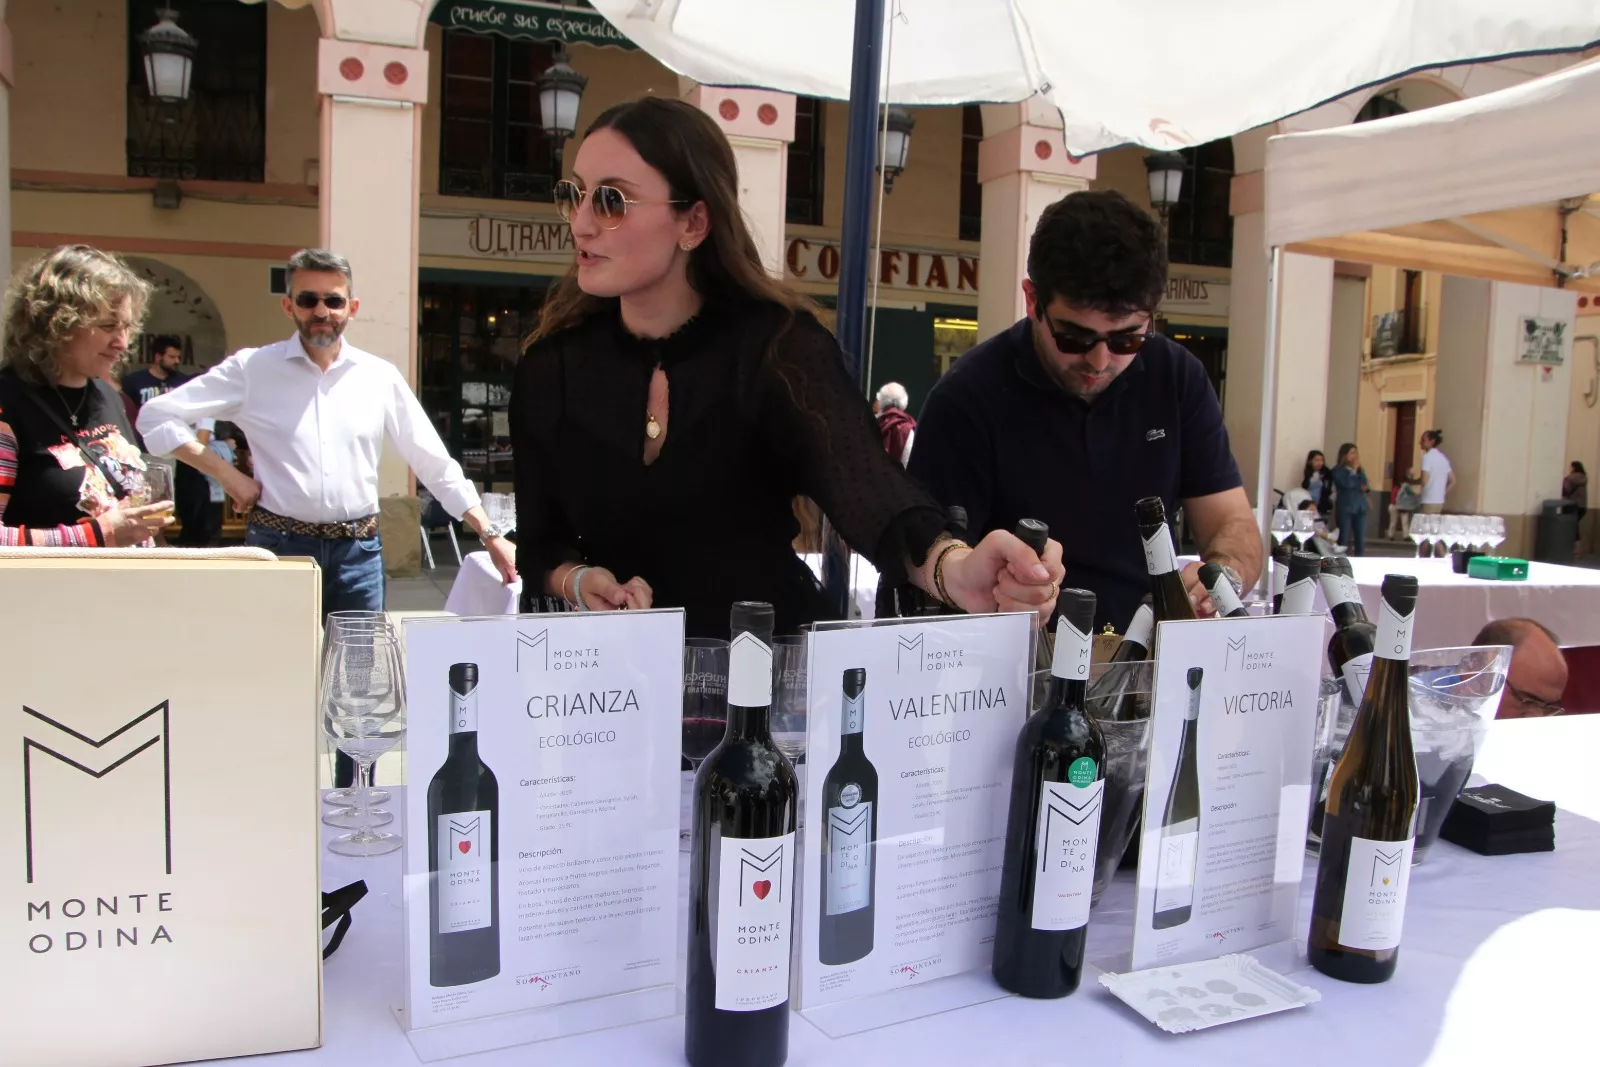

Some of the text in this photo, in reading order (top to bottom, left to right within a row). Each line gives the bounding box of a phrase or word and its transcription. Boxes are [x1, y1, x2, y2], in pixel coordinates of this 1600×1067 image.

[513, 14, 539, 29] sus
[787, 238, 979, 291] COFIAN
[554, 648, 600, 659] MONTE
[927, 649, 964, 660] MONTE
[1247, 652, 1275, 660] MONTE
[554, 660, 599, 671] ODINA
[927, 661, 963, 671] ODINA
[1246, 662, 1272, 671] ODINA
[526, 689, 640, 719] CRIANZA
[889, 687, 1007, 721] VALENTINA
[1223, 689, 1293, 715] VICTORIA
[539, 730, 616, 749] ECOLÓGICO
[908, 729, 971, 749] ECOLÓGICO
[519, 775, 576, 787] Características:
[518, 848, 564, 861] Descripción:
[450, 869, 480, 878] MONTE
[450, 877, 480, 886] ODINA
[27, 892, 173, 922] MONTE
[738, 921, 781, 934] MONTE
[28, 924, 173, 954] ODINA
[737, 933, 780, 945] ODINA
[736, 964, 778, 974] CRIANZA
